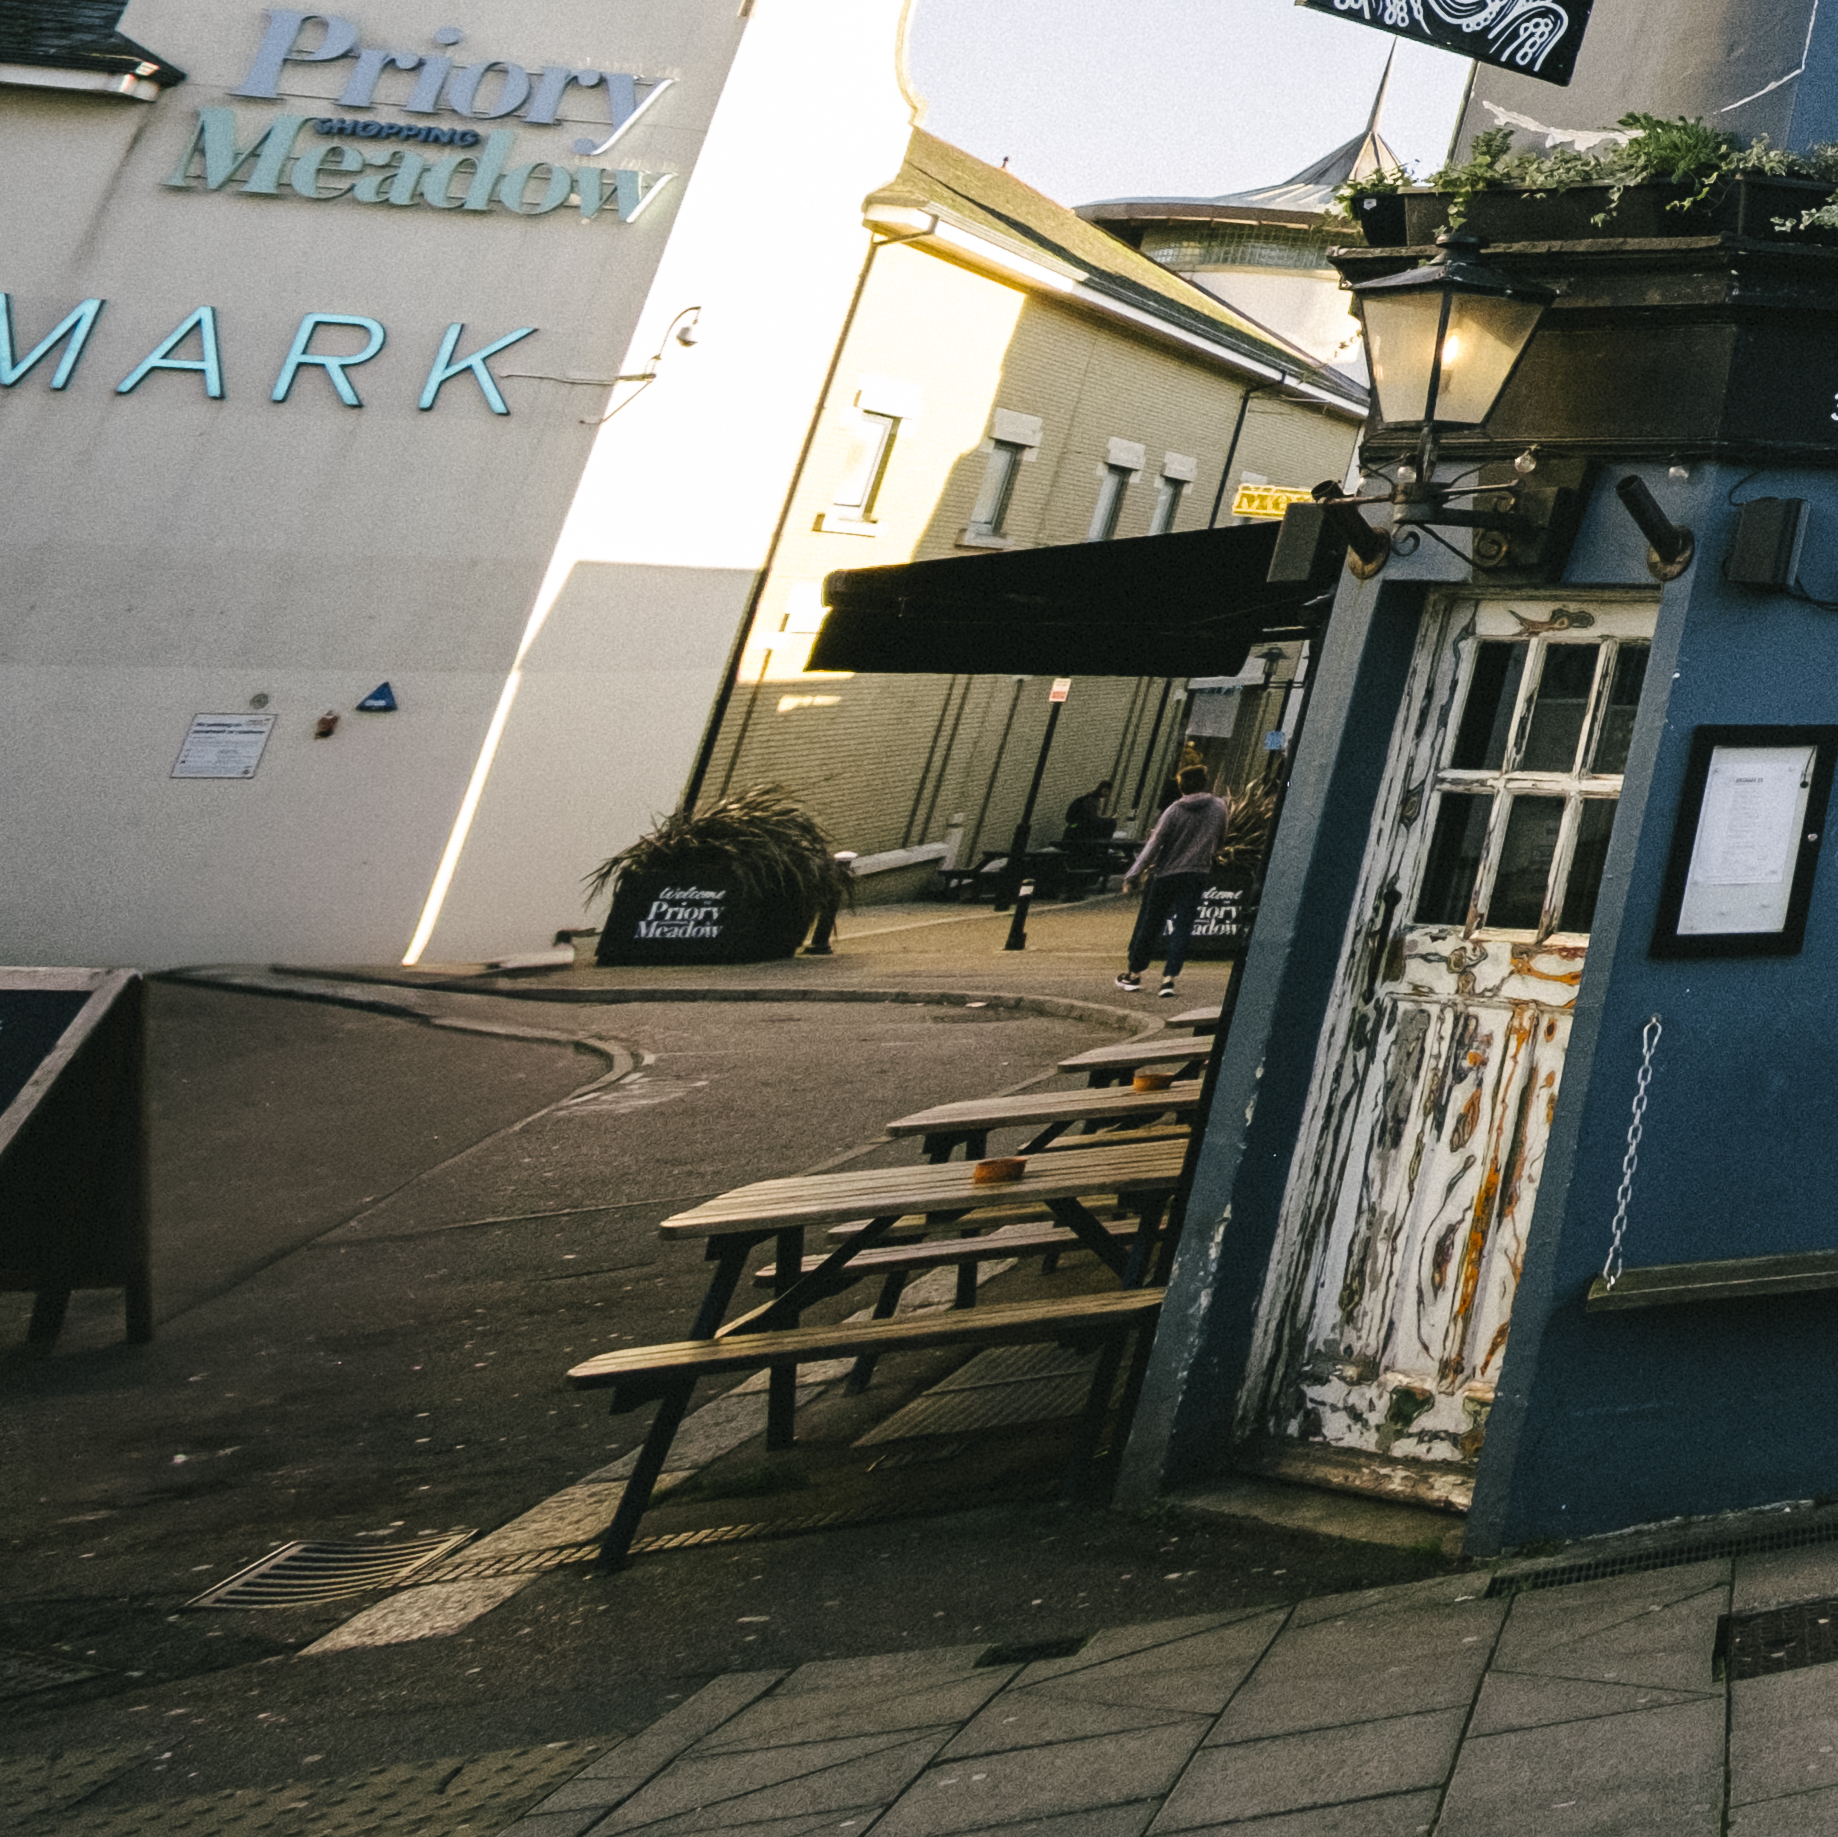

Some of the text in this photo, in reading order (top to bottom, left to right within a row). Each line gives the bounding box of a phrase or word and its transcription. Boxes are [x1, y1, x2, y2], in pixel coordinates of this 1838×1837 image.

[225, 8, 680, 155] Priory
[315, 117, 482, 147] SHOPPING
[160, 107, 679, 223] Meadow
[646, 900, 724, 923] Priory
[634, 920, 723, 938] Meadow
